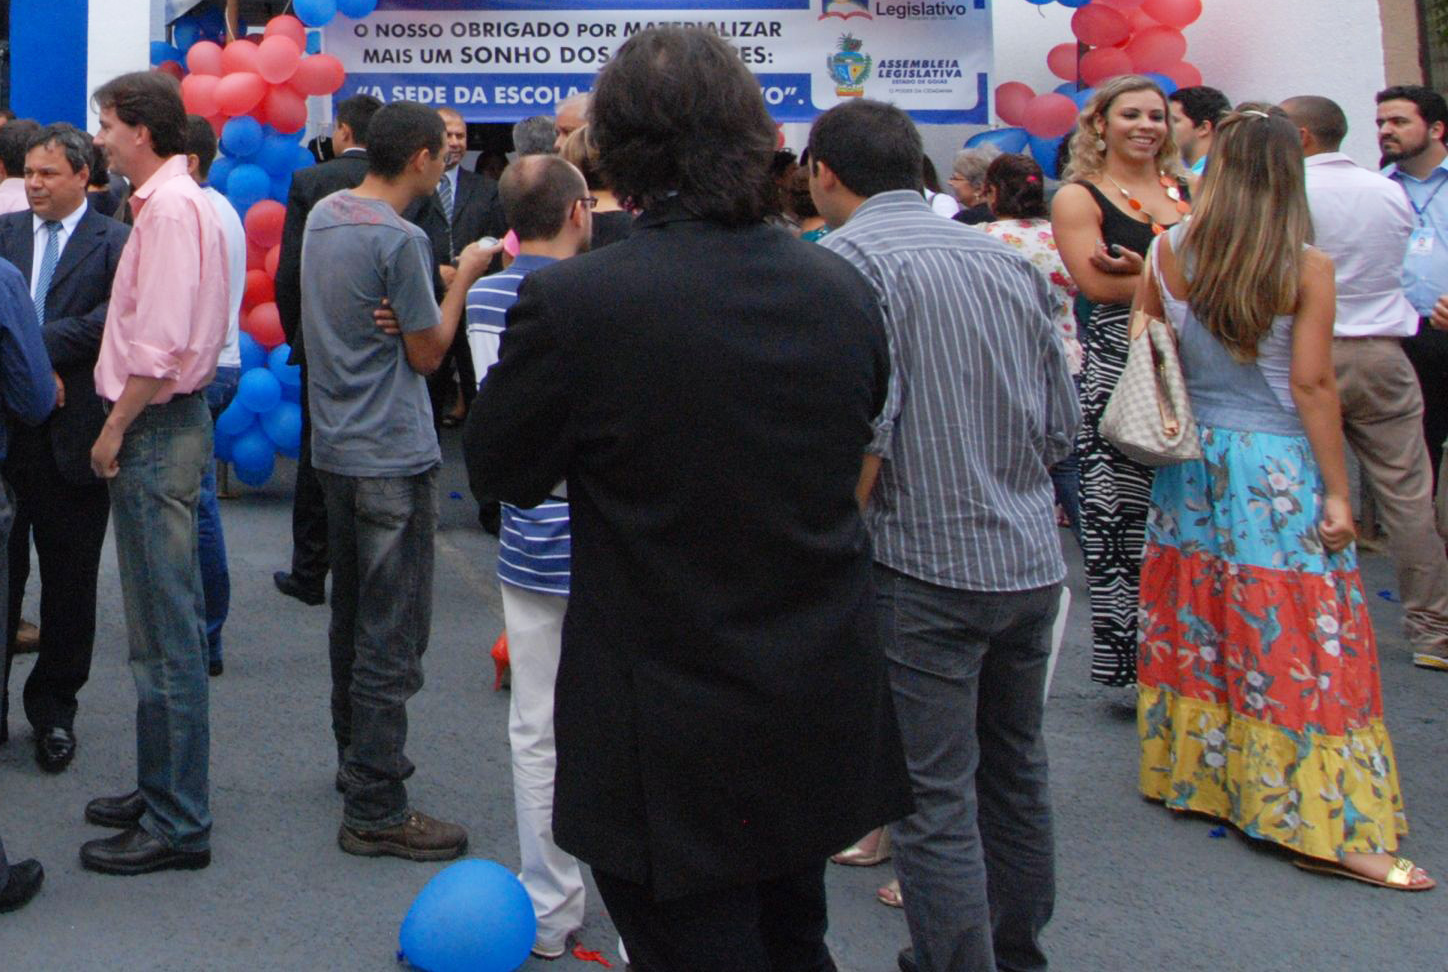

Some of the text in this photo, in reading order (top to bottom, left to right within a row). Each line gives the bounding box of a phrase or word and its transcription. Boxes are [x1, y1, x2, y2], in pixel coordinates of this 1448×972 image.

[875, 1, 967, 20] Legislativo
[353, 23, 369, 38] O
[375, 23, 444, 38] NOSSO
[451, 21, 570, 38] OBRIGADO
[577, 23, 617, 38] POR
[363, 46, 610, 65] MAIS UM SONHO DOS
[878, 59, 960, 69] ASSEMBLEIA
[878, 69, 963, 79] LEGISLATIVA
[392, 85, 447, 105] SEDE
[455, 86, 488, 105] DA
